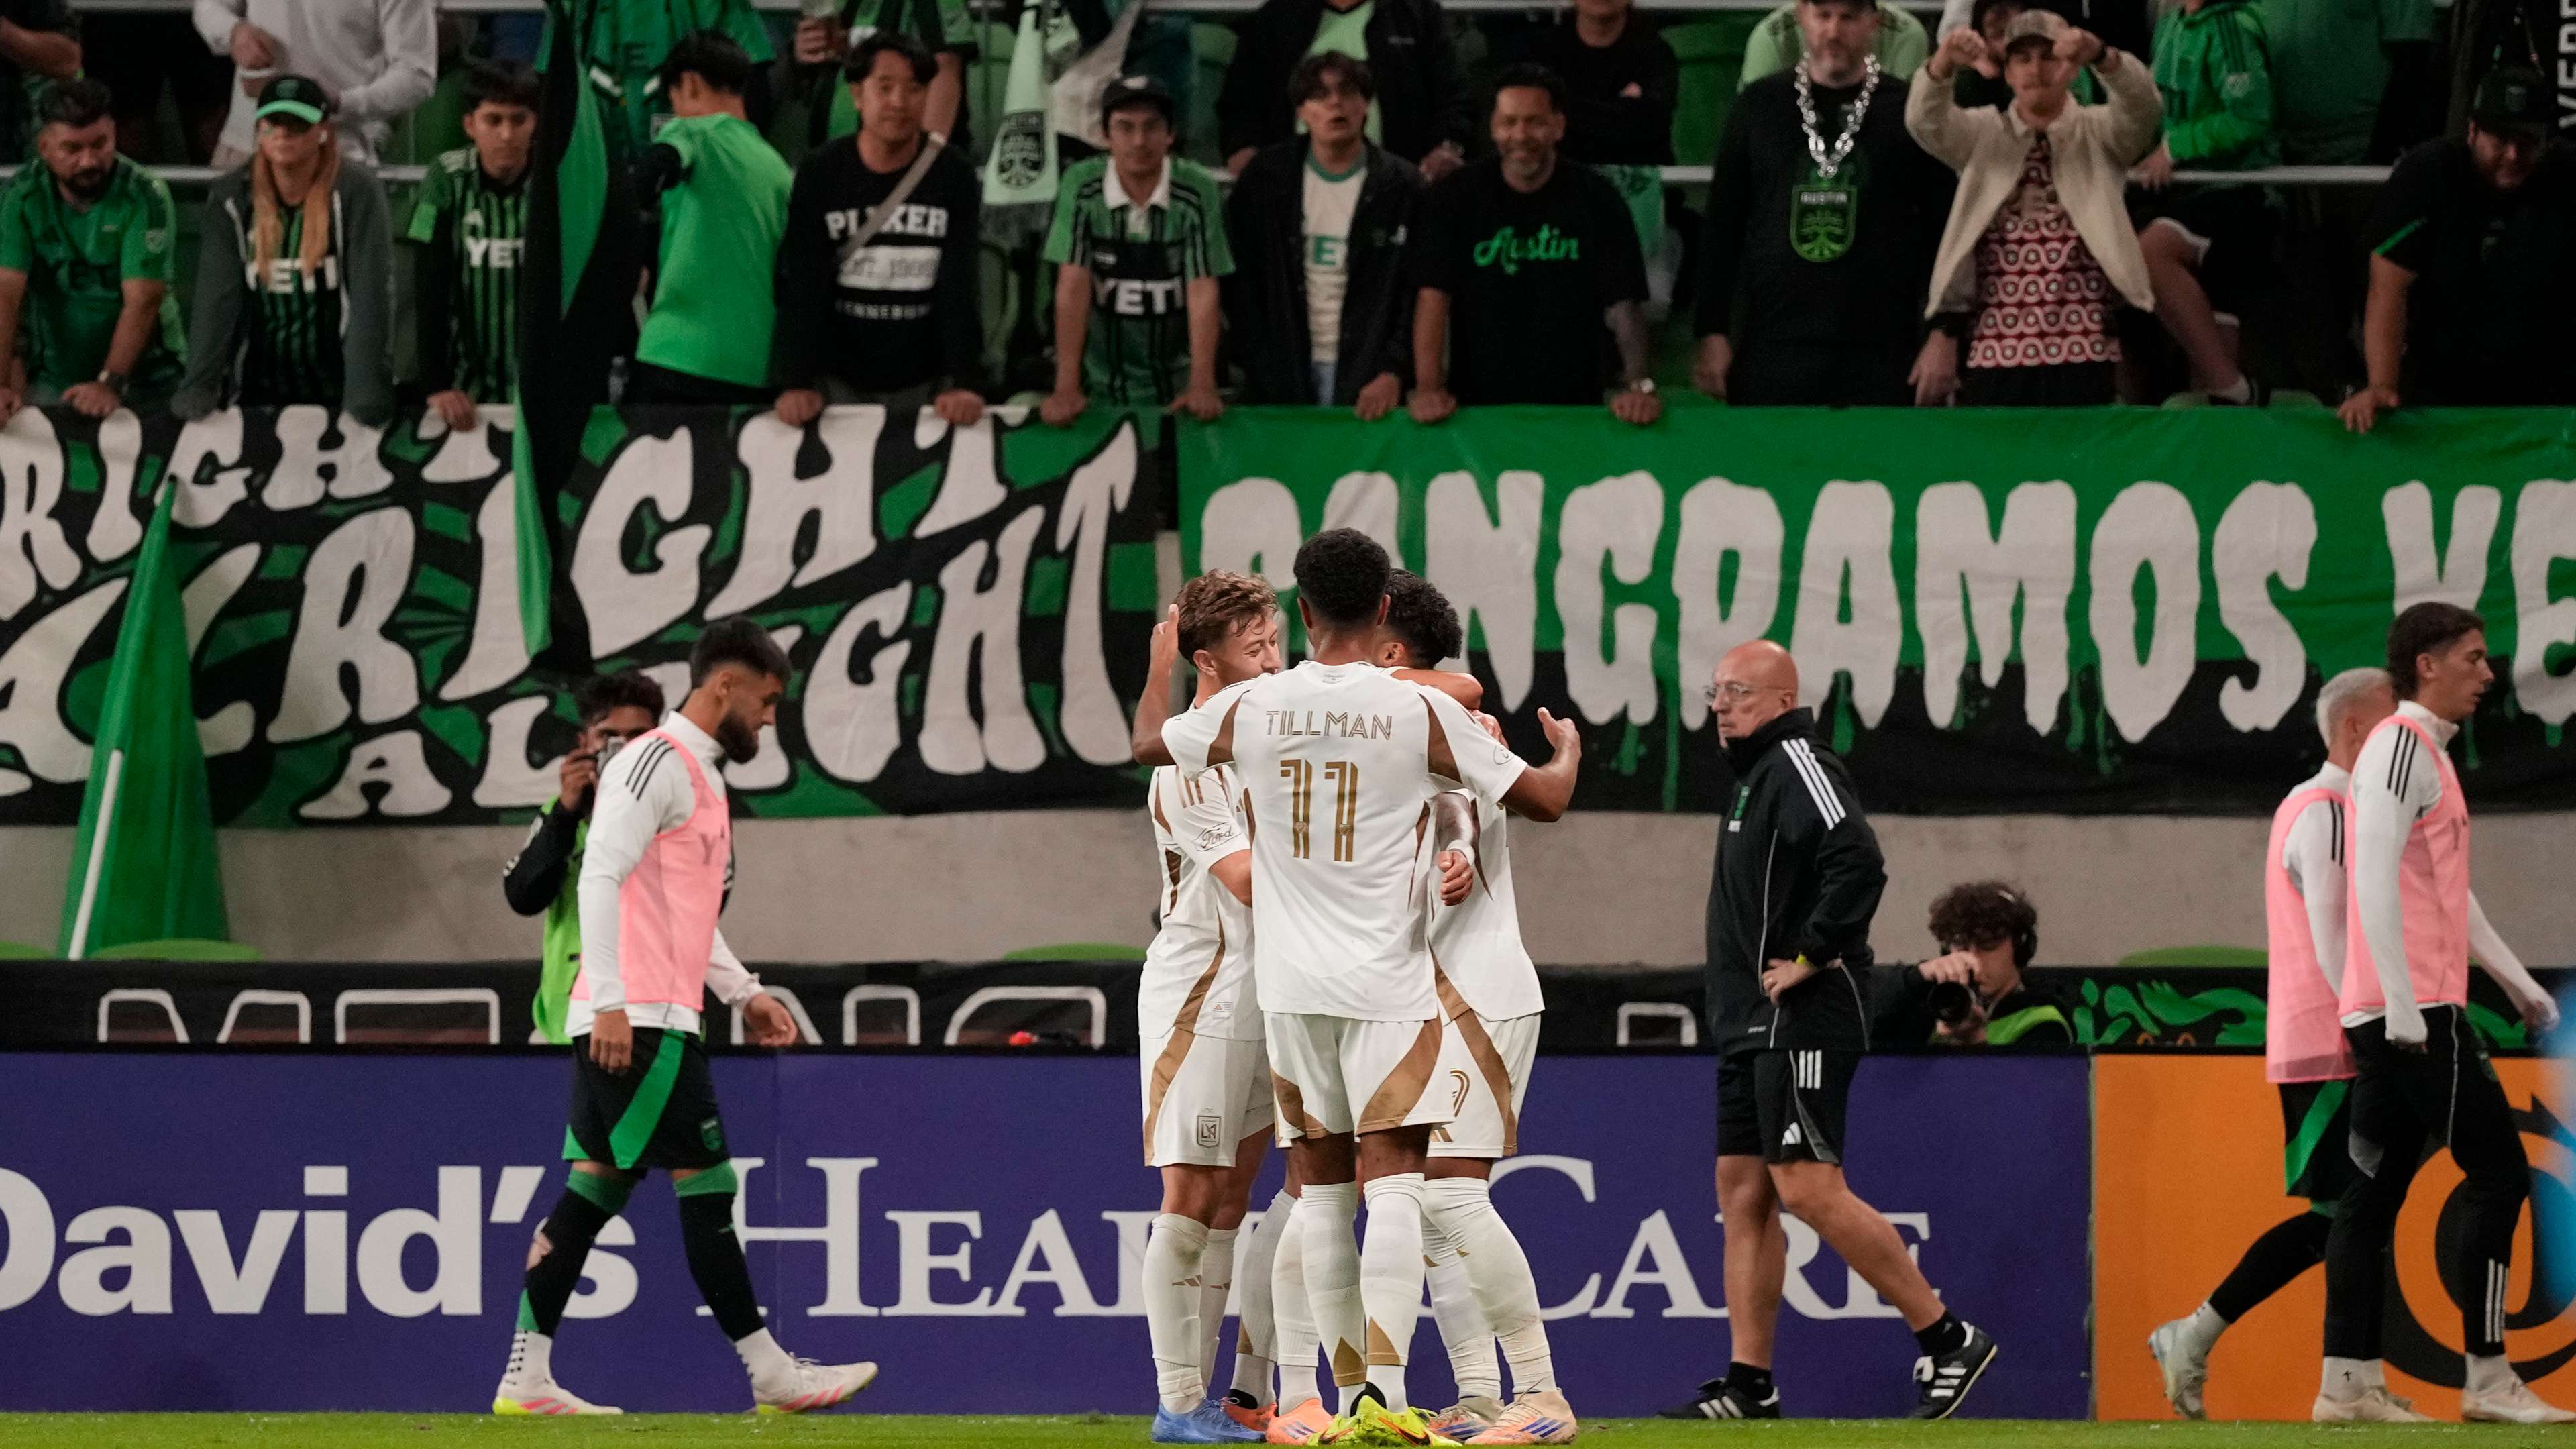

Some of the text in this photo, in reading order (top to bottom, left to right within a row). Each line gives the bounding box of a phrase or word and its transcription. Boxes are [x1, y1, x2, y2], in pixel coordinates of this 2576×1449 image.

[1474, 223, 1578, 276] Austin
[1094, 276, 1184, 316] YETI
[1266, 710, 1393, 741] TILLMAN
[1280, 759, 1358, 862] 11
[1201, 826, 1234, 849] Ford
